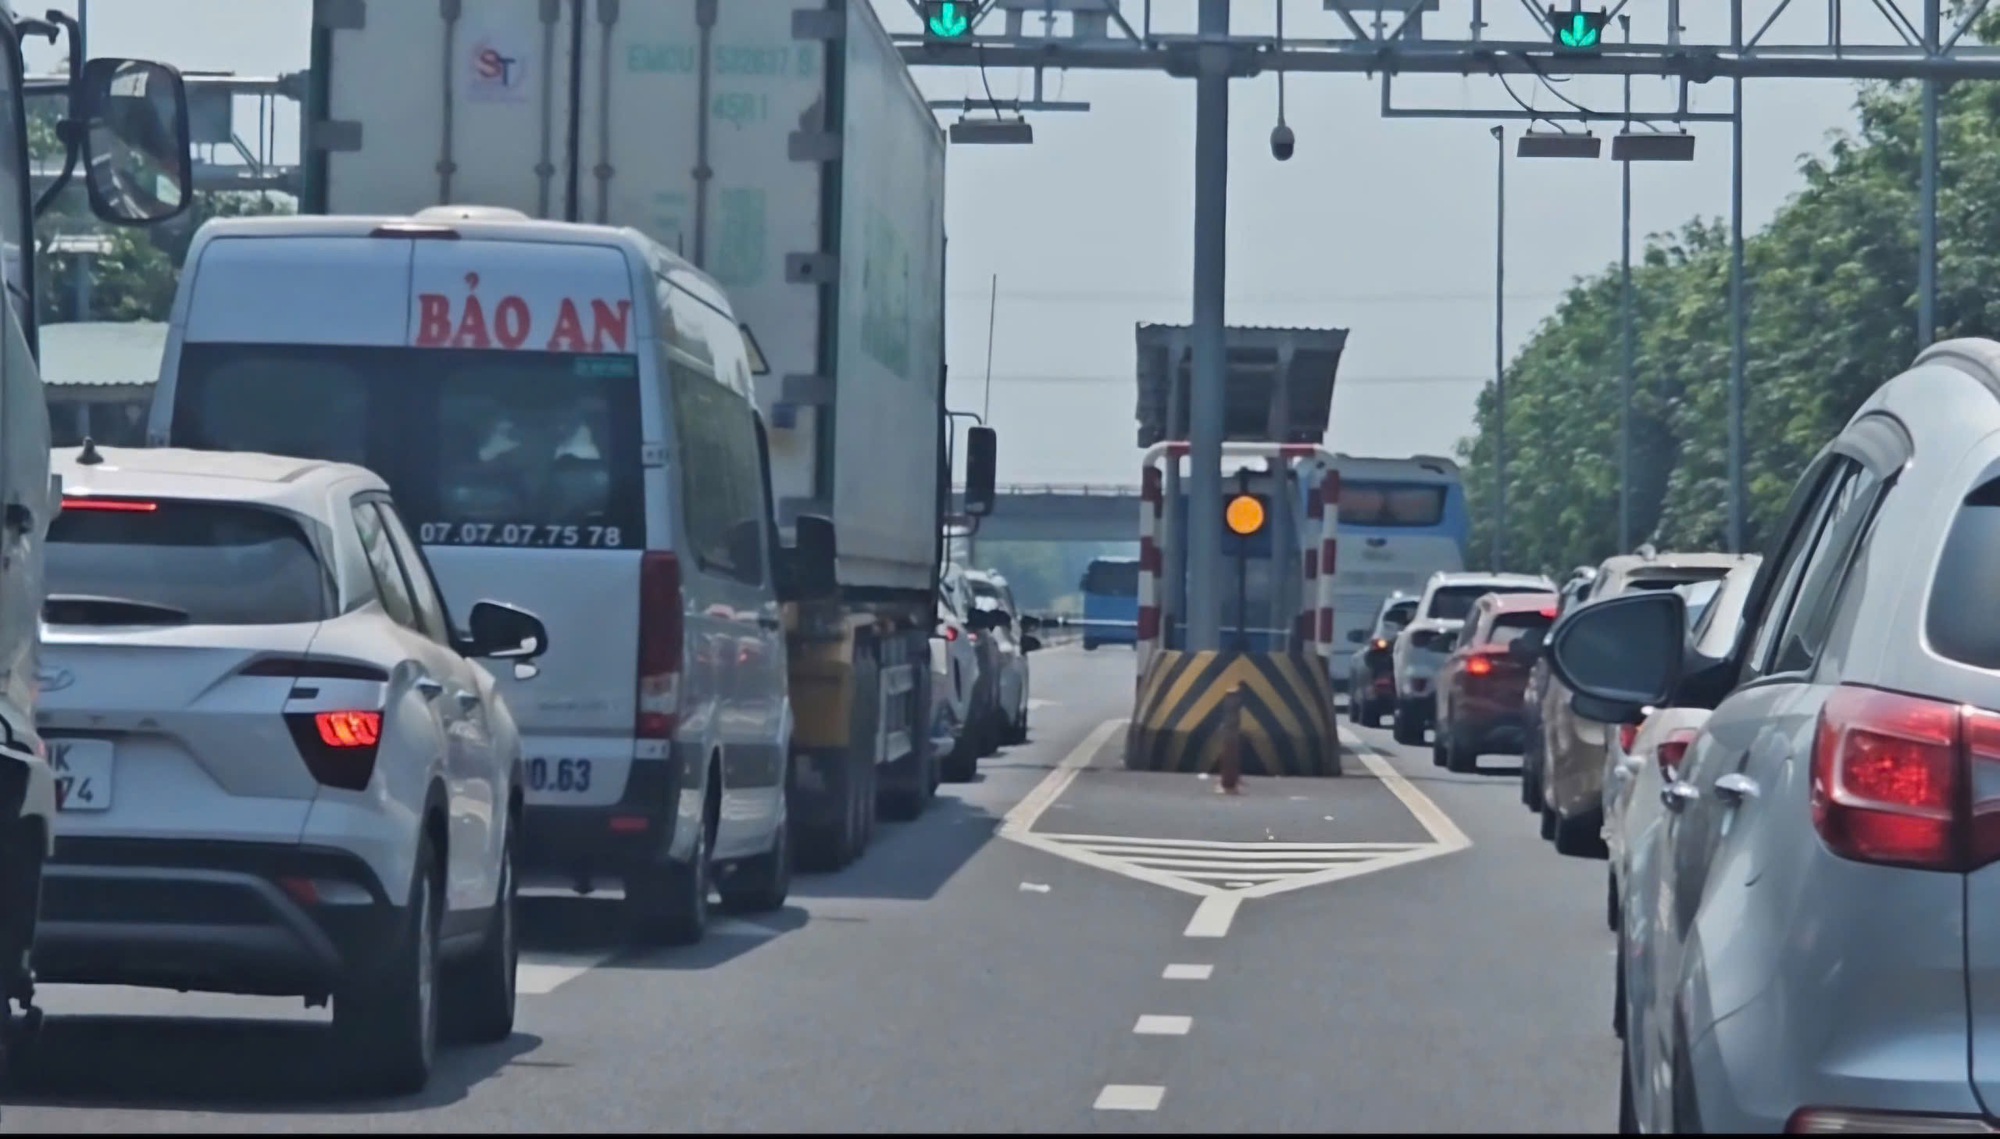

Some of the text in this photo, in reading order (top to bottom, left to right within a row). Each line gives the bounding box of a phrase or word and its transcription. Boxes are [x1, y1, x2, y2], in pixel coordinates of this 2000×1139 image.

[415, 272, 631, 353] BẢO AN
[420, 523, 621, 547] 07.07.07.75 78
